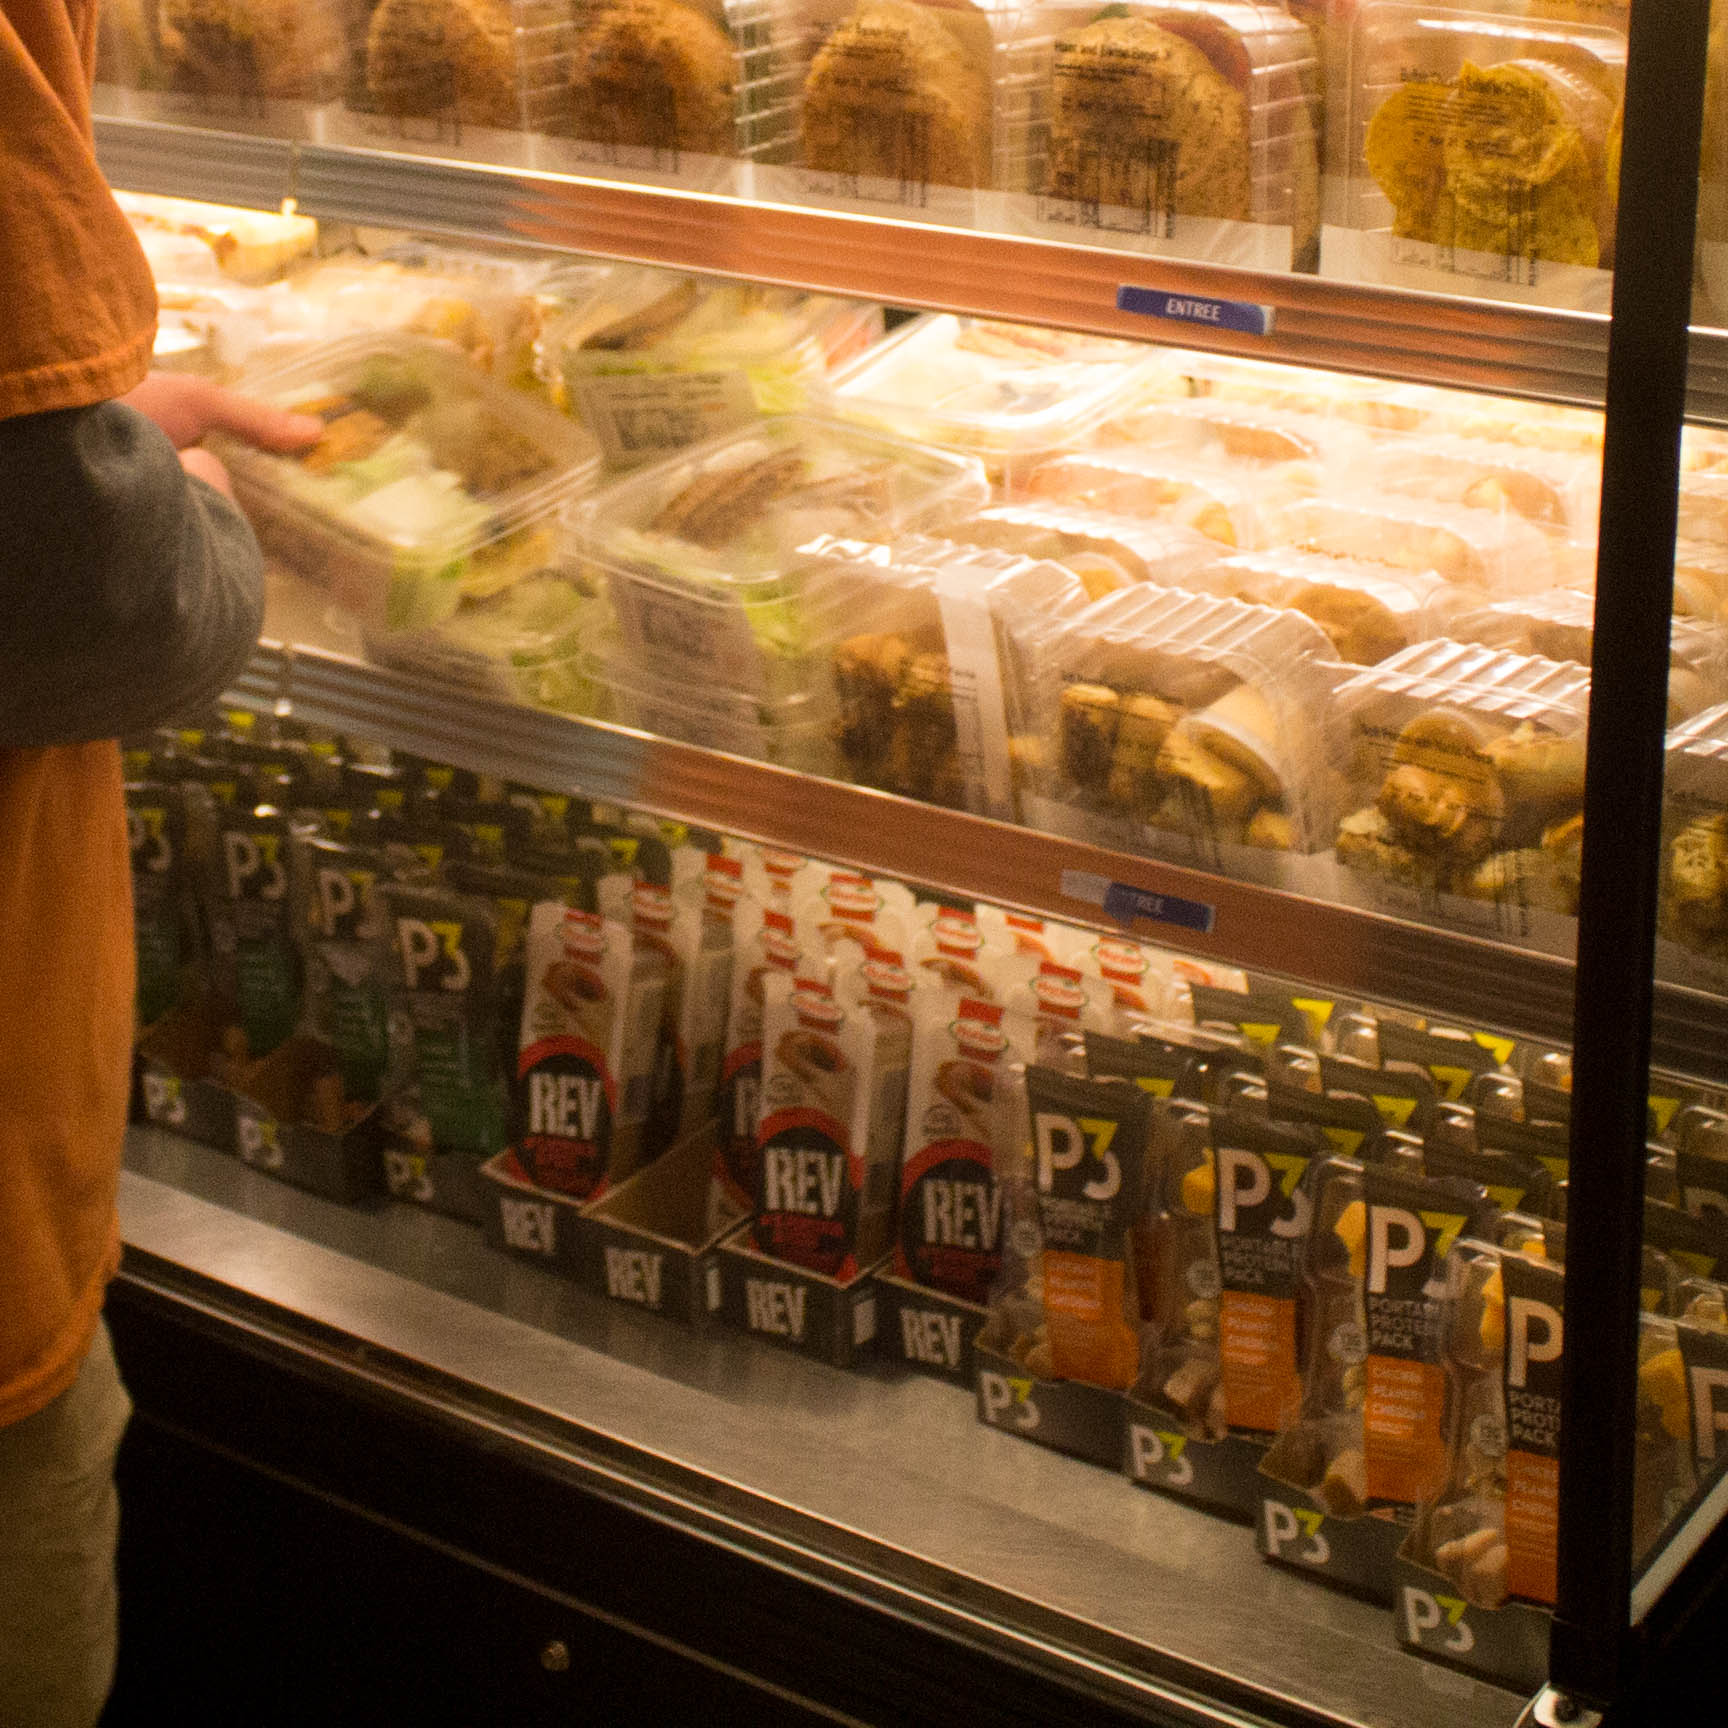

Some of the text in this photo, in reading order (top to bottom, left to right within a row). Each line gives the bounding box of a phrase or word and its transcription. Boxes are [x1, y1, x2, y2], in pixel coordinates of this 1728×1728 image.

[1165, 297, 1222, 321] ENTREE
[224, 830, 290, 902] P3
[398, 918, 470, 992] P3
[528, 1072, 604, 1140] REV
[236, 1113, 284, 1169] P3
[1033, 1111, 1122, 1201] P3
[384, 1150, 436, 1203] P3
[763, 1146, 845, 1218] REV
[1217, 1145, 1313, 1239] P3
[499, 1196, 557, 1255] REV
[922, 1176, 1003, 1251] REV
[604, 1245, 664, 1309] REV
[745, 1278, 807, 1342] REV
[899, 1307, 965, 1370] REV
[1507, 1294, 1565, 1388] P
[980, 1370, 1040, 1429] P3
[1129, 1422, 1195, 1485] P3
[1262, 1496, 1331, 1565] P3
[1401, 1583, 1475, 1654] P3
